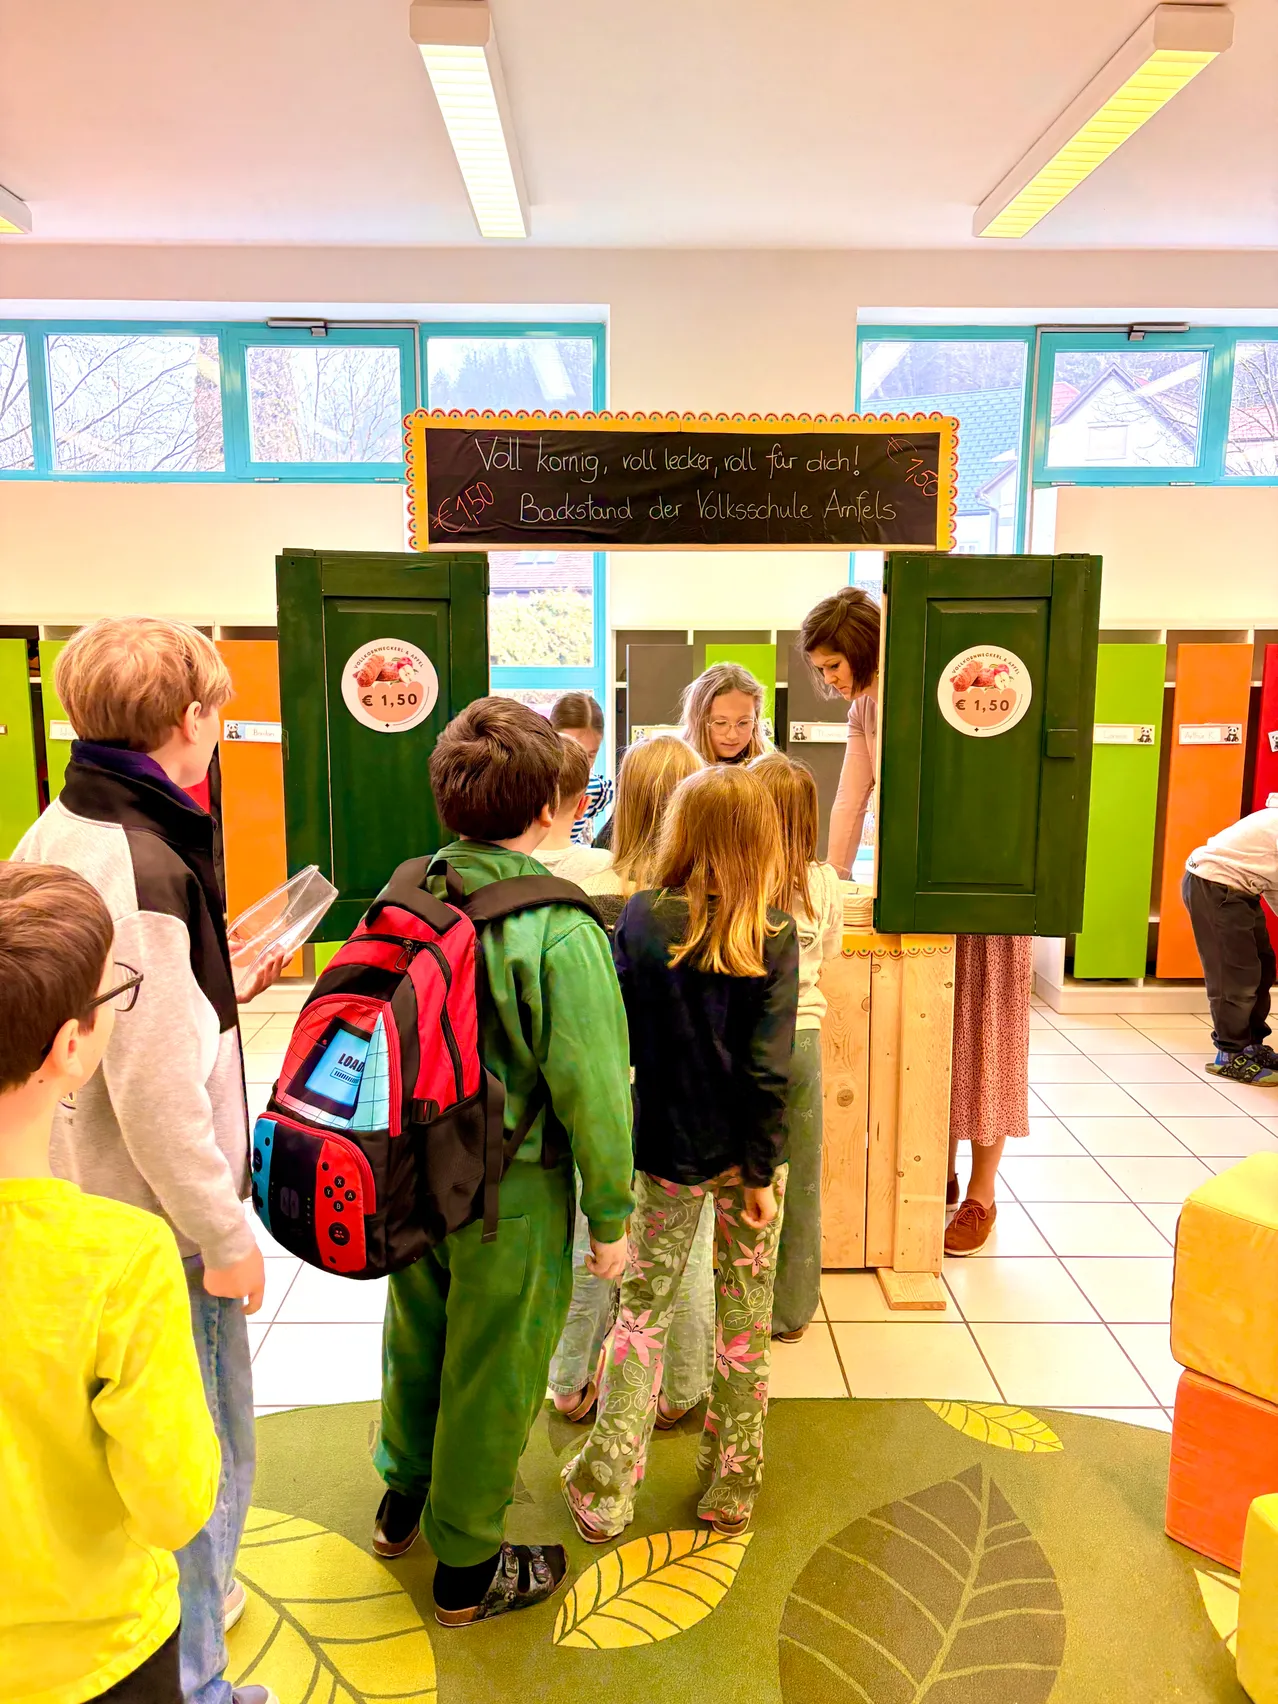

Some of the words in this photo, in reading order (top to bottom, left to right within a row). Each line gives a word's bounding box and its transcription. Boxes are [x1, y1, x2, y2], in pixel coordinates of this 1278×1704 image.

[475, 436, 522, 471] Voll
[664, 446, 718, 479] lecker,
[765, 442, 799, 479] für
[806, 445, 860, 476] dich!
[519, 492, 633, 523] Backstand
[649, 495, 682, 520] der
[696, 489, 813, 520] Volksschule
[823, 488, 897, 523] Arnfels
[362, 694, 373, 707] €
[381, 693, 418, 708] 1,50
[955, 699, 966, 711] €
[974, 699, 1010, 713] 1,50
